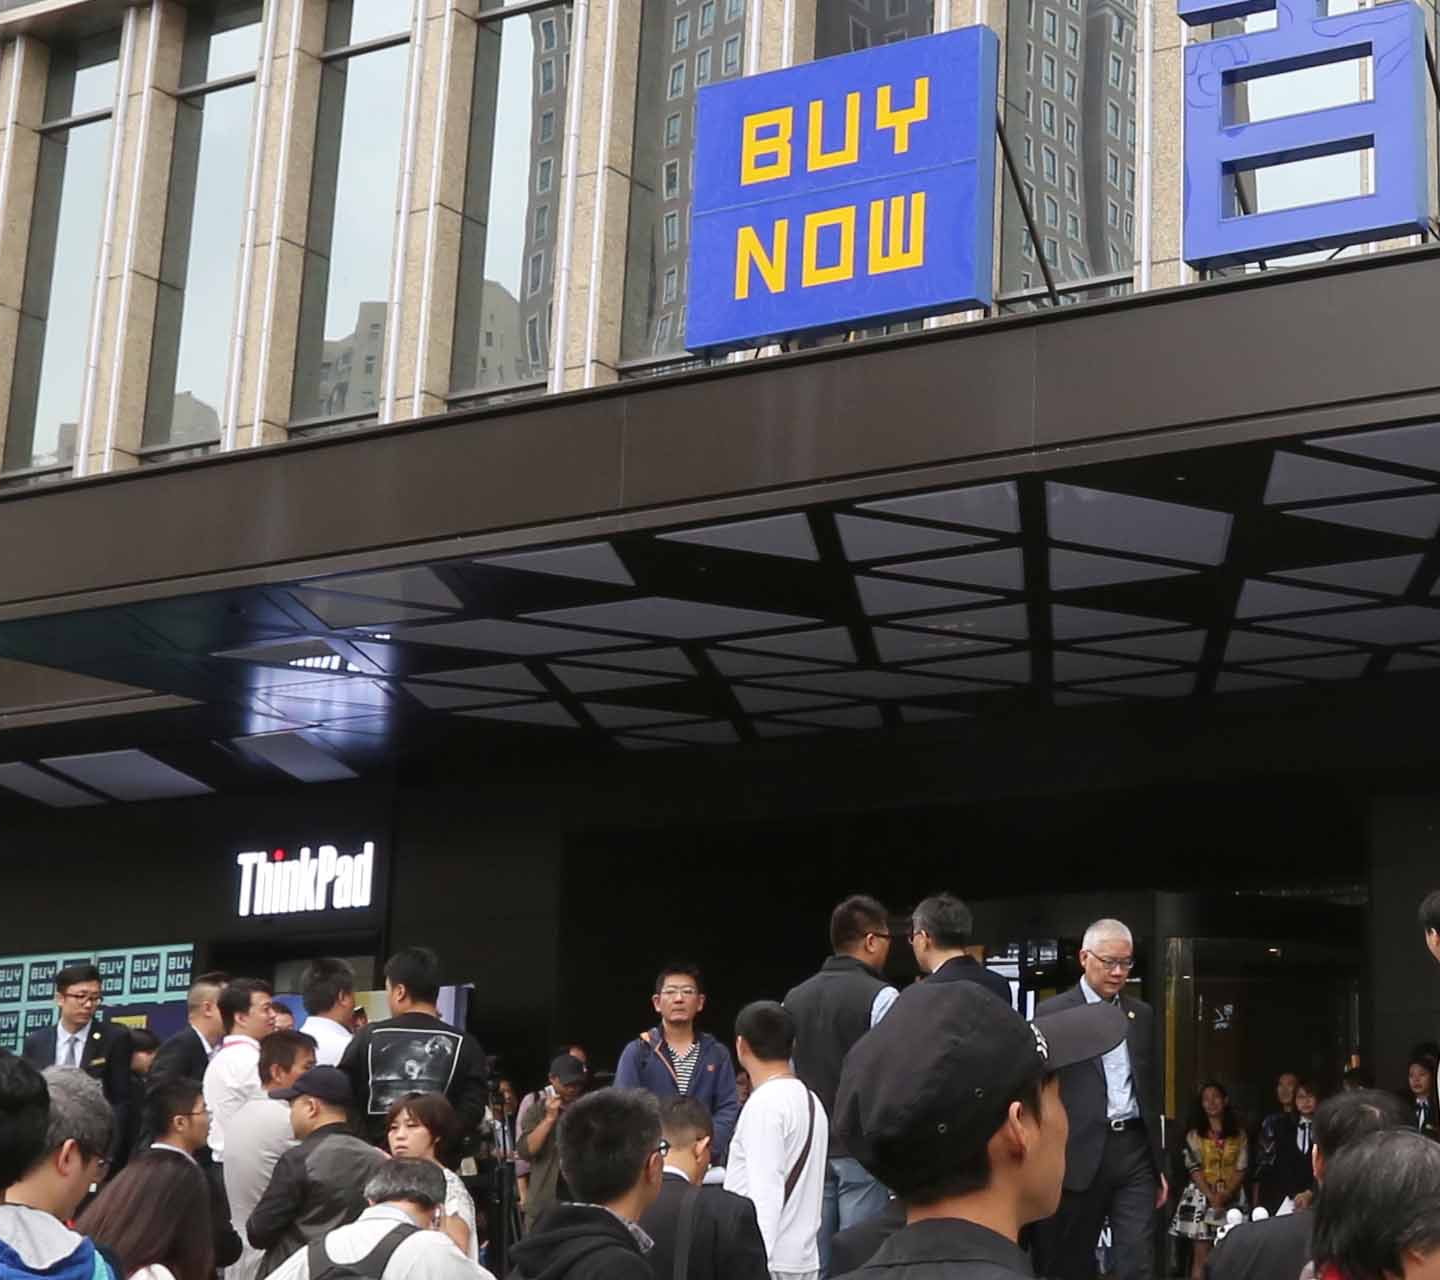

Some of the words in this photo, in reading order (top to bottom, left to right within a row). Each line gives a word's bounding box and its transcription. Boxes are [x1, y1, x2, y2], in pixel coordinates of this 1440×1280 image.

[740, 76, 929, 186] BUY
[734, 191, 926, 300] NOW
[237, 841, 374, 916] ThinkPad
[99, 960, 124, 975] BUY
[133, 958, 159, 972] BUY
[168, 955, 192, 971] BUY
[31, 965, 56, 980] BUY
[29, 982, 54, 997] NOW
[132, 975, 158, 990] NOW
[27, 1014, 51, 1027] BUY
